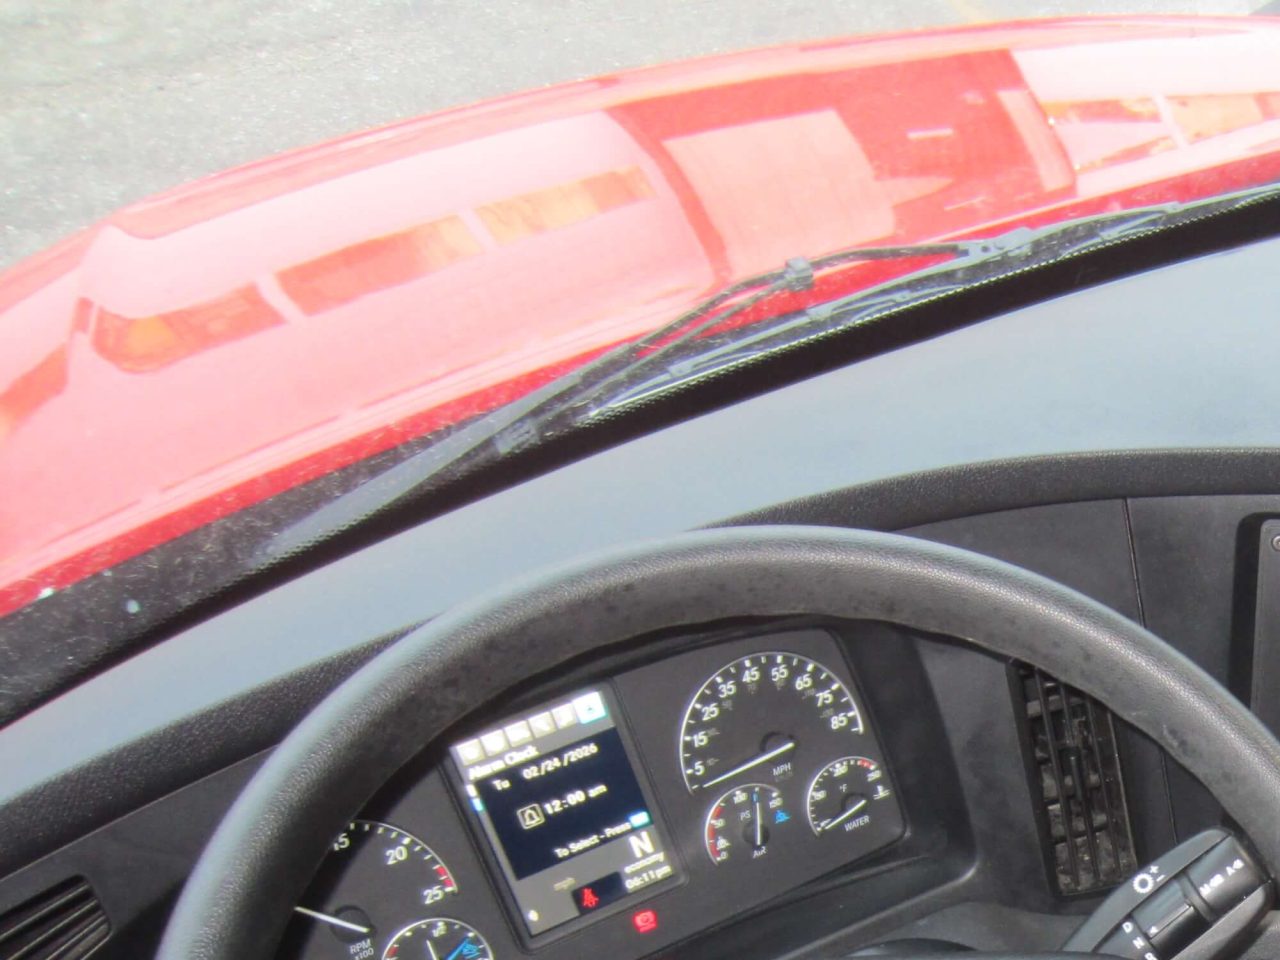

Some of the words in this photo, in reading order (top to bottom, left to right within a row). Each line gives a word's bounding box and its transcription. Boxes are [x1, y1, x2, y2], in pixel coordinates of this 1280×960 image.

[742, 666, 760, 683] 45
[771, 667, 789, 682] 55
[795, 674, 812, 691] 65
[718, 681, 736, 698] 35
[815, 690, 833, 707] 75
[701, 703, 719, 721] 25
[831, 713, 848, 730] 85
[693, 731, 708, 748] 15
[694, 761, 705, 776] 5
[772, 762, 791, 777] MPH
[545, 790, 586, 815] 12:00
[844, 815, 870, 832] WATER
[628, 830, 655, 858] N
[386, 846, 408, 865] 20
[423, 886, 444, 905] 25
[1122, 922, 1133, 934] D
[1132, 937, 1145, 950] N
[349, 938, 371, 955] RPM
